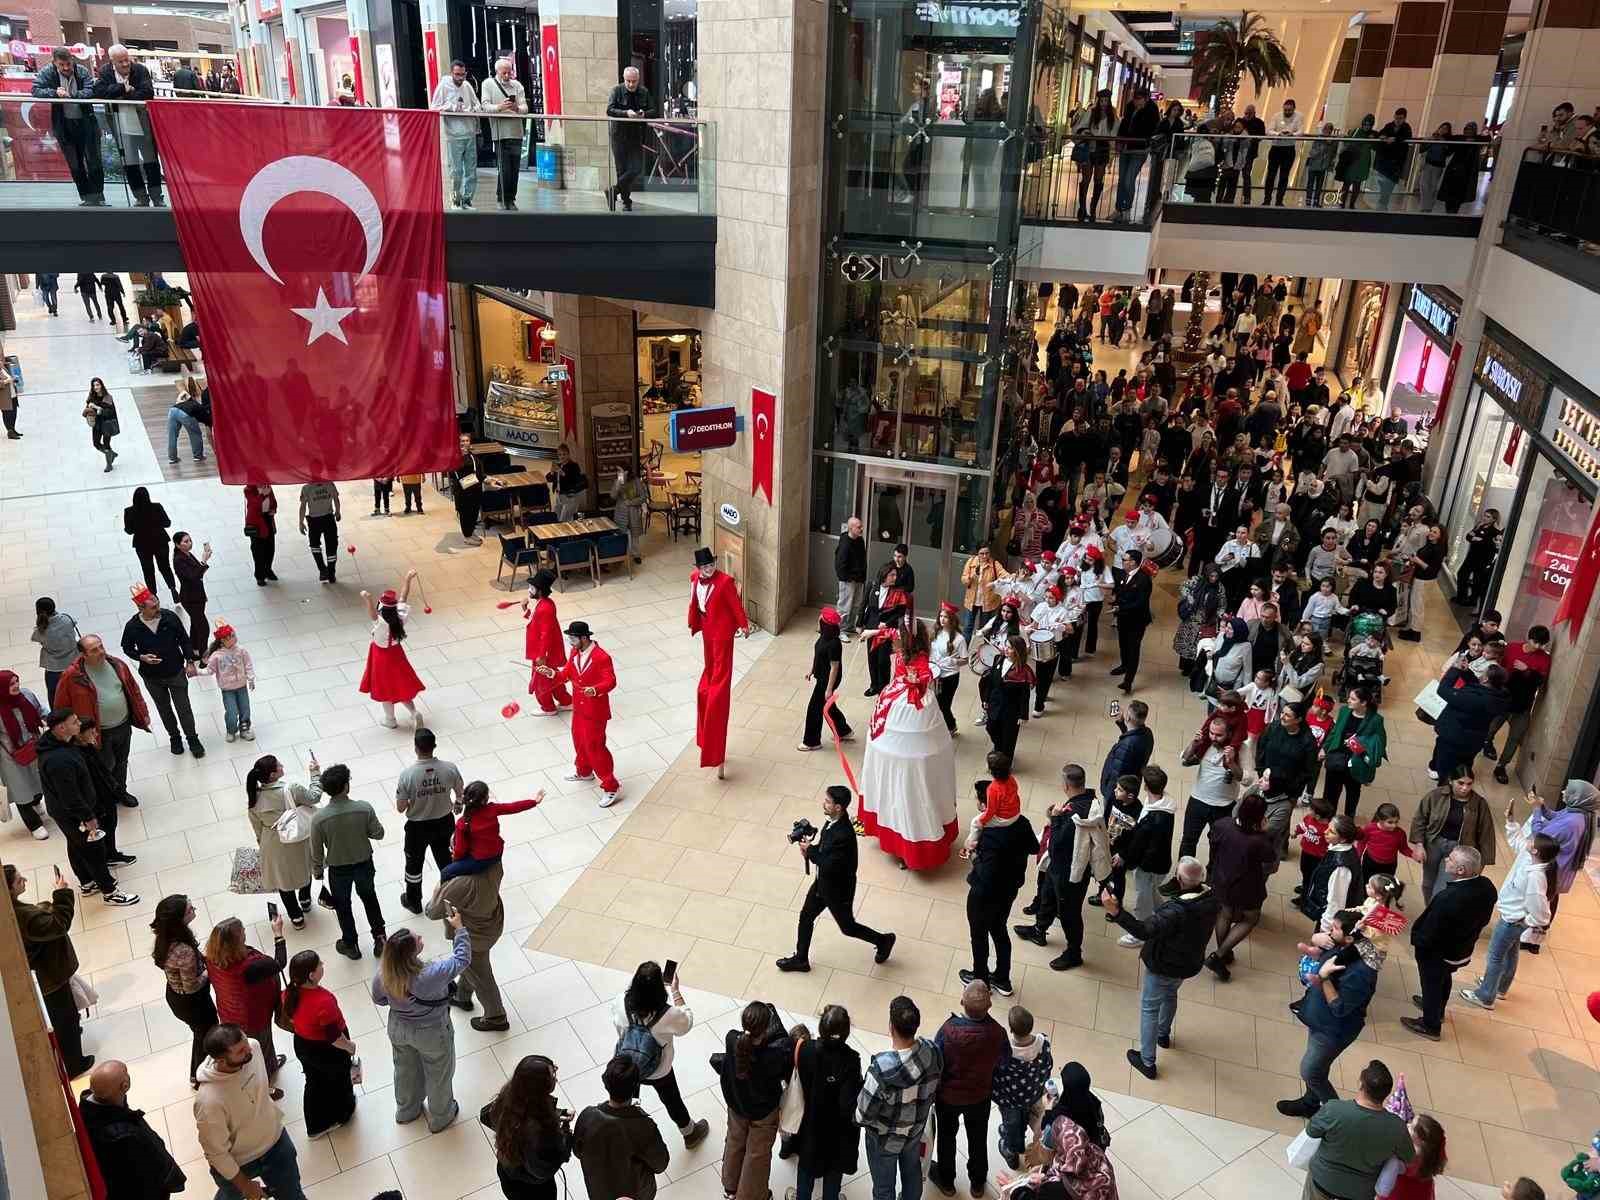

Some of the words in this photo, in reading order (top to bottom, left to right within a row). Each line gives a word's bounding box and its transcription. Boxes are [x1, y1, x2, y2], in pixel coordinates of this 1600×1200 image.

[696, 422, 733, 433] DECATHLON
[505, 429, 540, 443] MADO
[1543, 570, 1550, 581] 1
